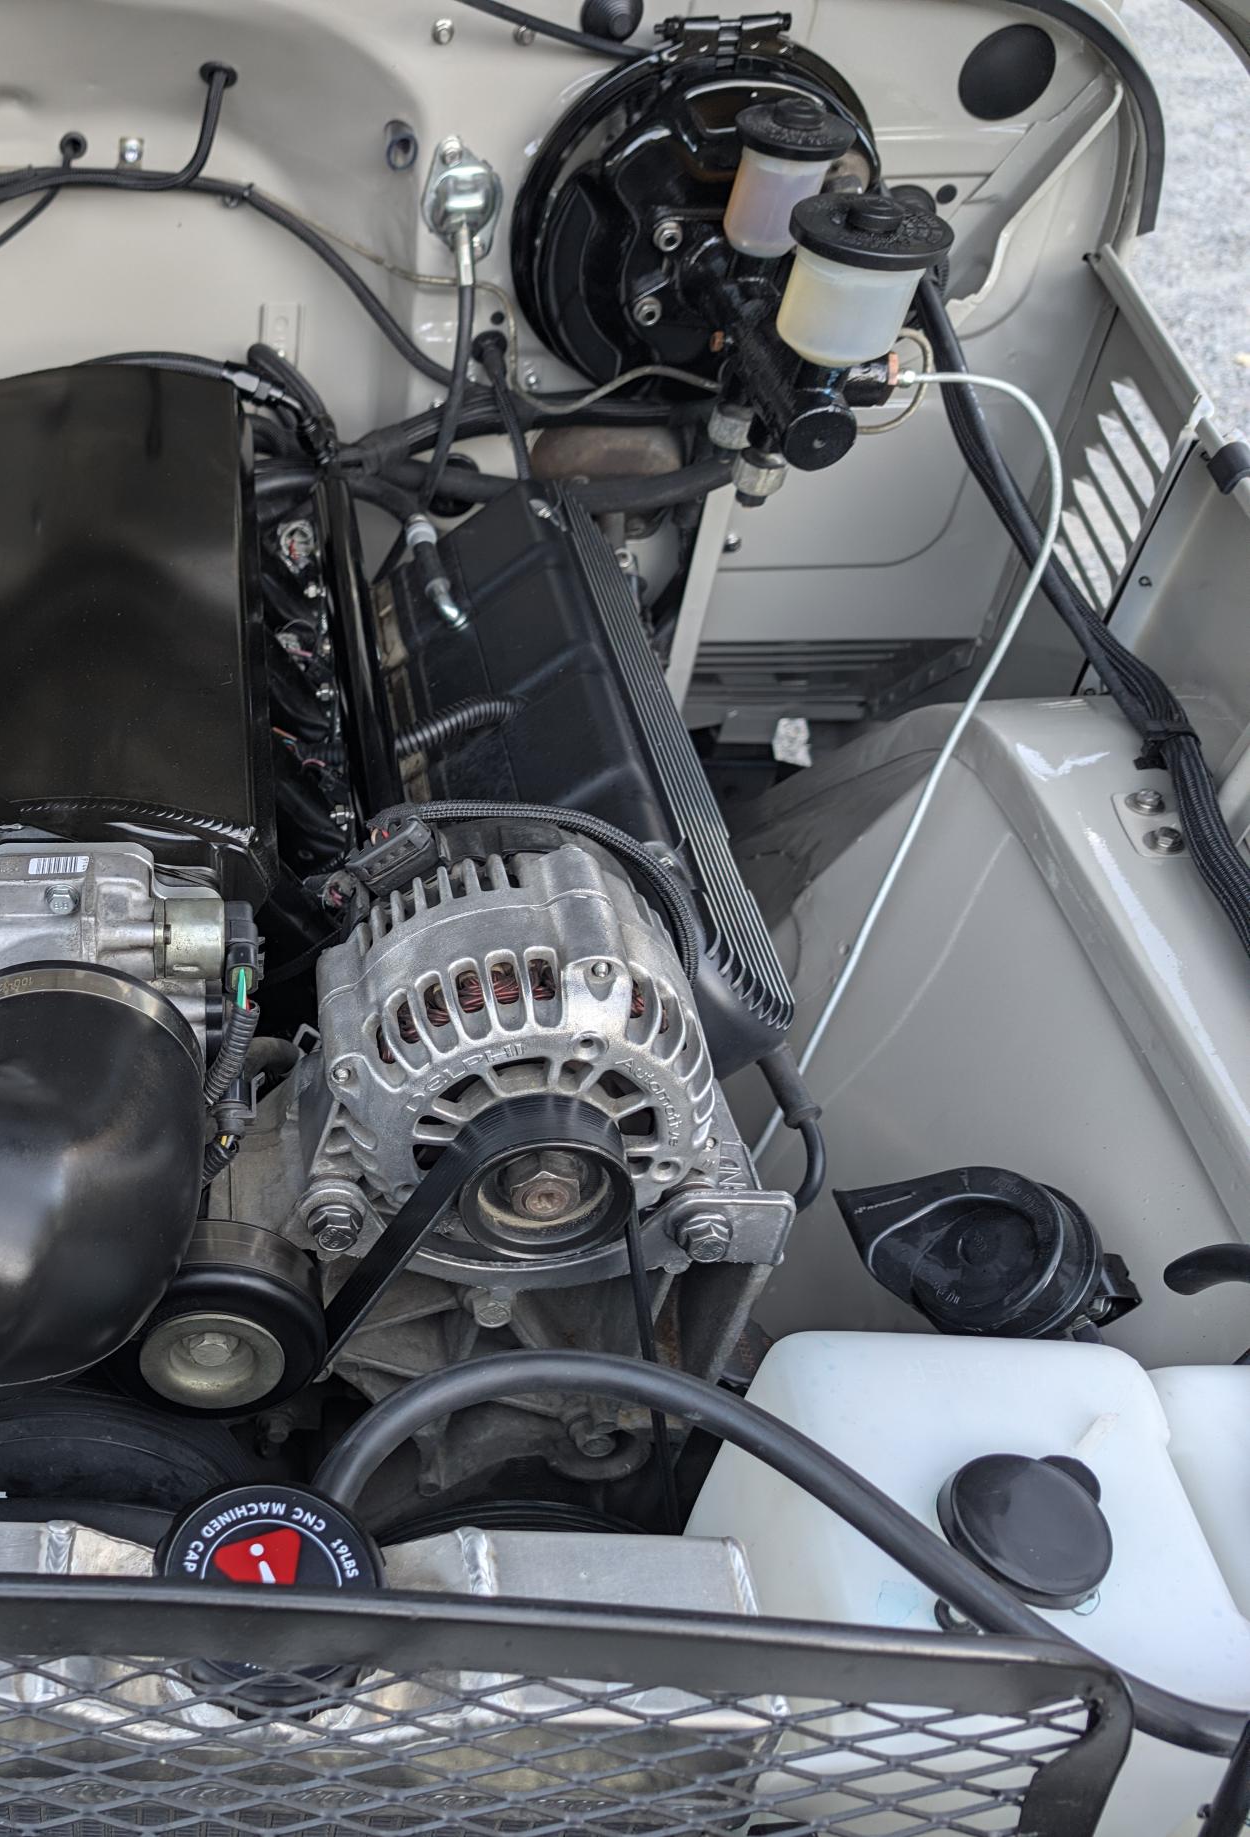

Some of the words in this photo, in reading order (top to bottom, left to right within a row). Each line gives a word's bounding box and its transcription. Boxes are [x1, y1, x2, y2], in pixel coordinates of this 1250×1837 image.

[615, 1057, 680, 1147] Automotive
[201, 1501, 287, 1539] MACHINED
[291, 1507, 327, 1532] CNC
[183, 1540, 204, 1573] CAP
[330, 1538, 360, 1578] 19LBS
